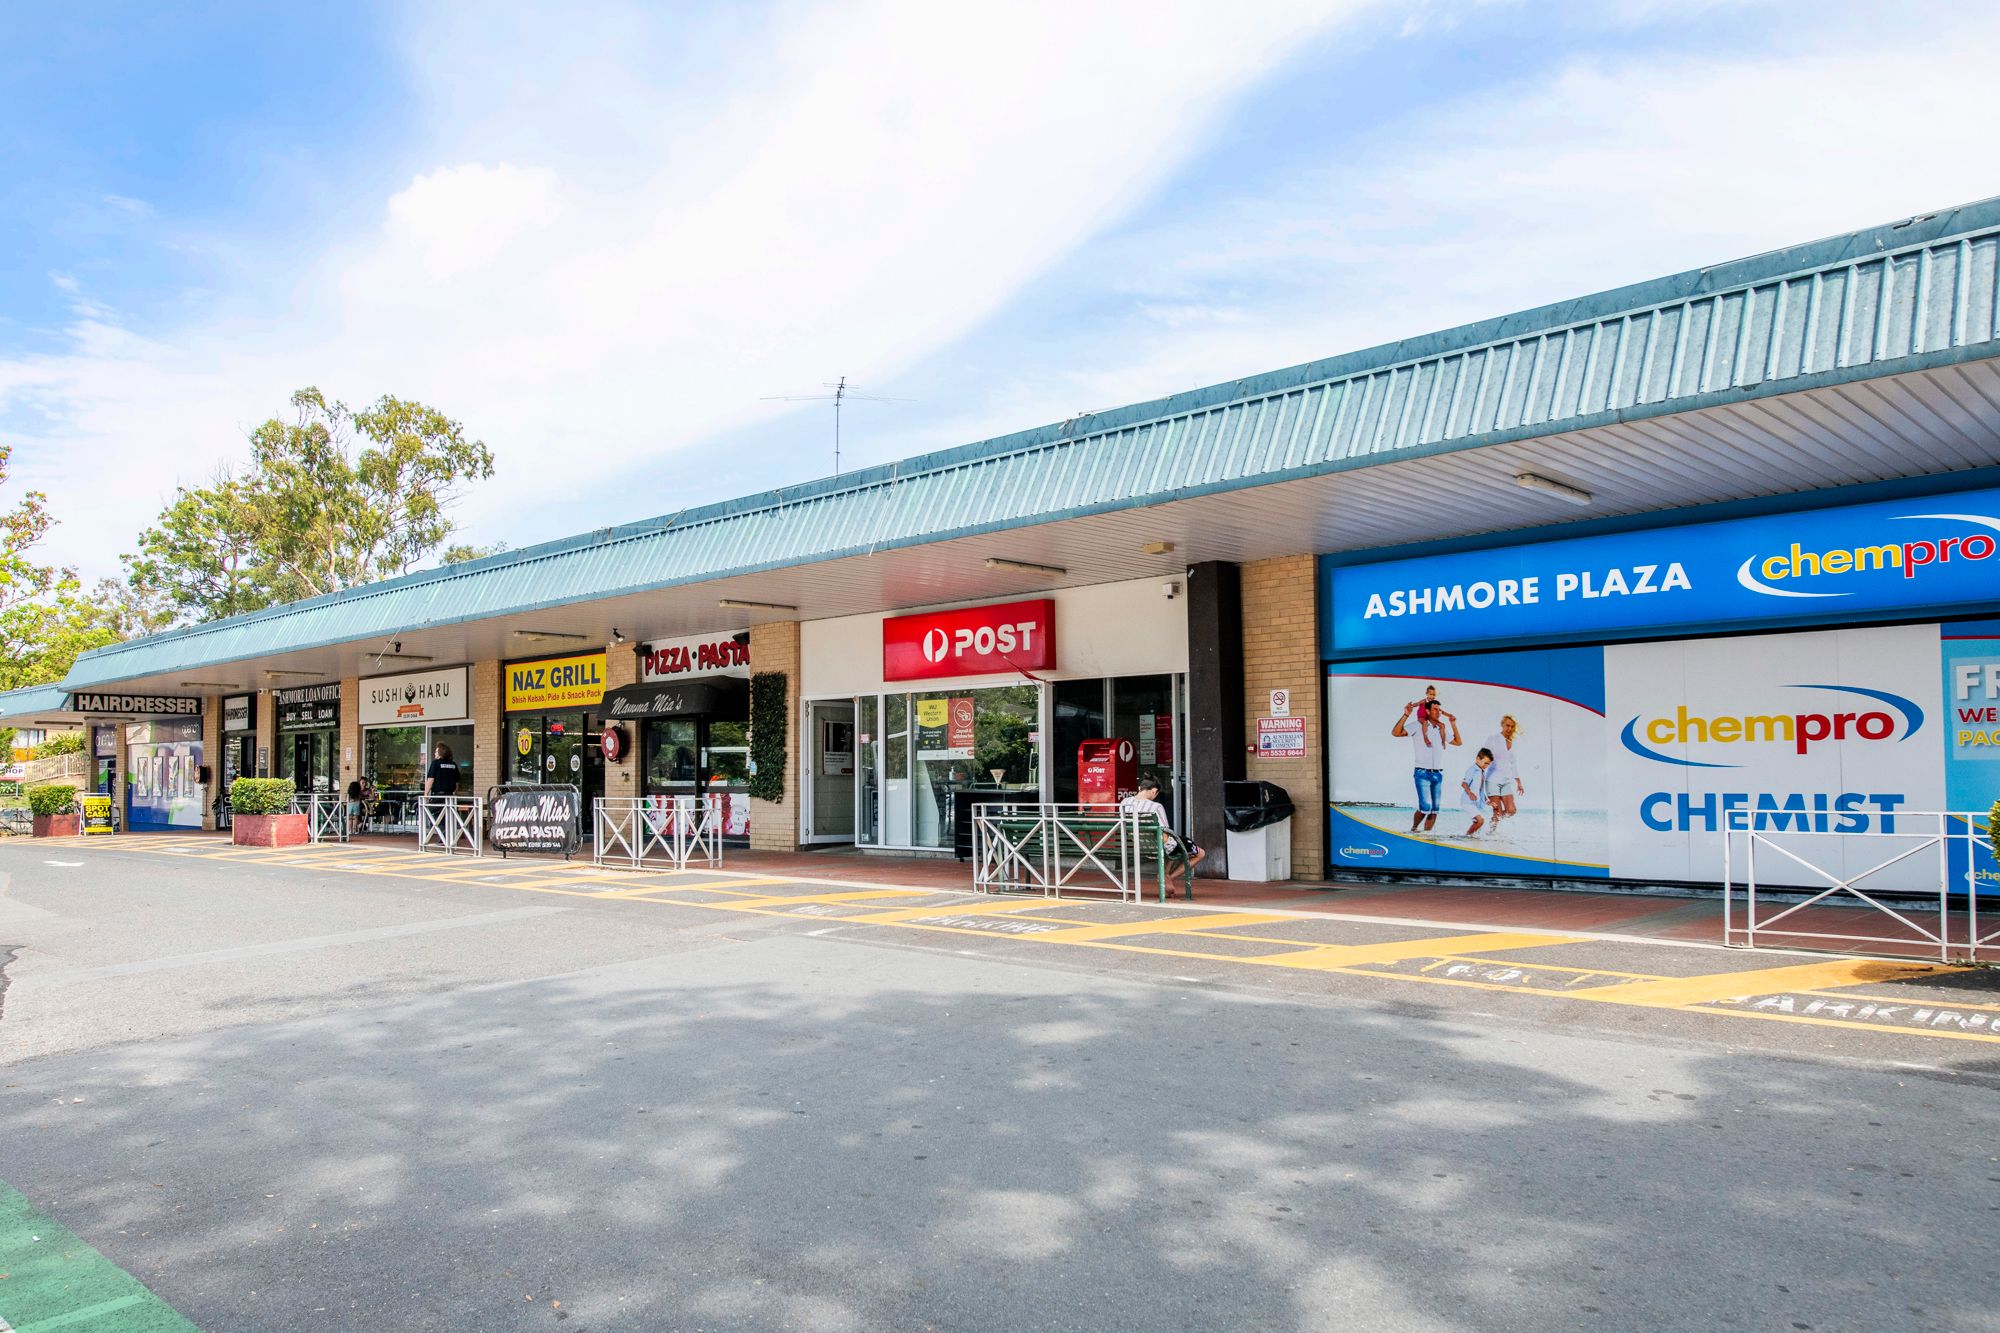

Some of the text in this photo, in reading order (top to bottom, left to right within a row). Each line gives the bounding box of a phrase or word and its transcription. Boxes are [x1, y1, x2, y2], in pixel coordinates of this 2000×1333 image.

[1761, 534, 1996, 580] chempro
[1363, 562, 1693, 619] ASHMORE PLAZA
[955, 621, 1036, 657] POST
[645, 641, 750, 676] PIZZA PASTA
[513, 663, 601, 692] NAZ GRILL
[78, 695, 197, 714] HAIRDRESSER
[305, 687, 321, 702] LOAN
[371, 682, 450, 704] SUSHI HARU
[511, 696, 527, 704] Shish
[547, 692, 560, 701] Pide
[561, 692, 566, 700] &
[567, 690, 585, 699] Snack
[586, 688, 602, 698] Pack
[610, 693, 683, 714] Mamma Mia's
[286, 709, 333, 721] BUY SELL LOAN
[1260, 719, 1303, 729] WARNING
[1646, 706, 1895, 754] chempro
[494, 795, 571, 824] Mamma Mia's
[1640, 791, 1905, 834] CHEMIST
[496, 826, 566, 840] PIZZA PASTA
